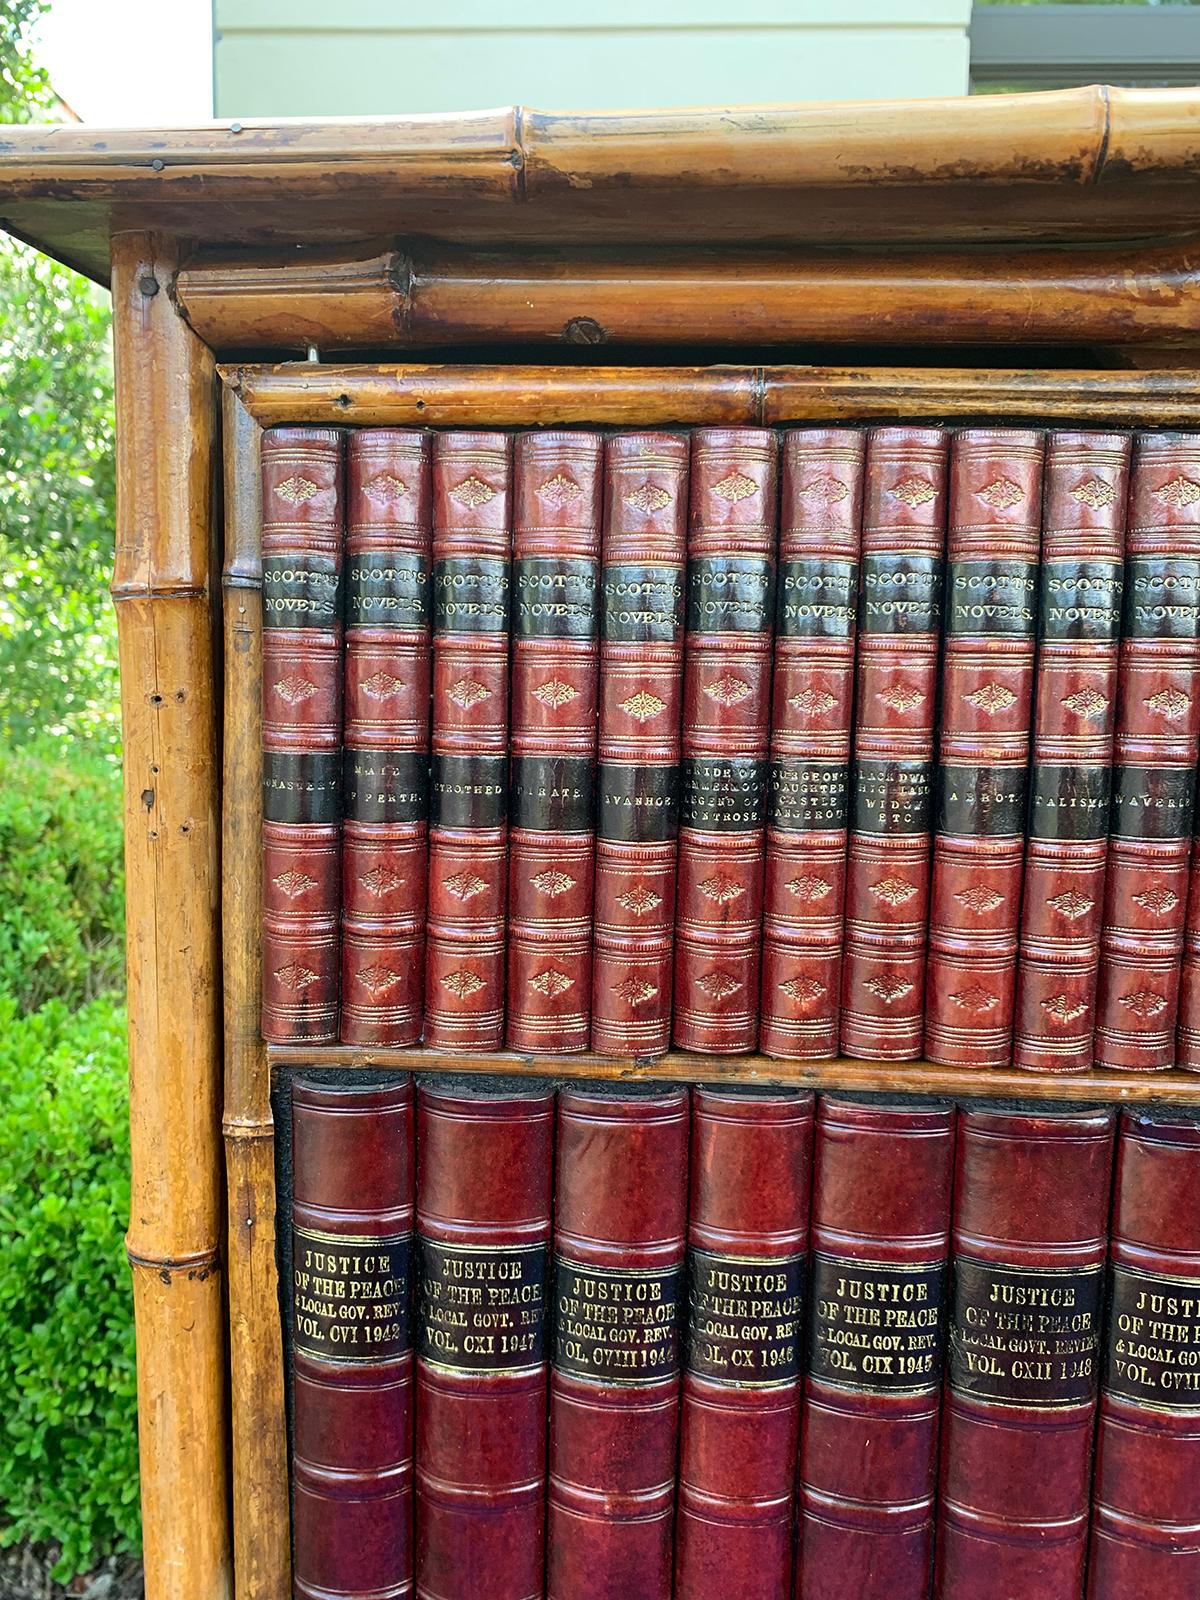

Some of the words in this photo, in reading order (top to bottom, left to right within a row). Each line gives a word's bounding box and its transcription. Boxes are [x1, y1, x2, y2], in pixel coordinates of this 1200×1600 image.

[352, 569, 426, 584] SCOTT'S
[956, 576, 1034, 591] SCOTT'S
[1048, 578, 1123, 593] SCOTT'S
[605, 583, 681, 597] SCOTT'S
[353, 597, 425, 612] NOVELS.
[437, 602, 508, 617] NOVELS.
[956, 606, 1033, 620] NOVELS.
[607, 611, 680, 625] NOVELS.
[779, 795, 837, 806] CASTLE
[879, 812, 915, 823] ETC.
[305, 1251, 390, 1274] JUSTICE
[443, 1259, 522, 1280] JUSTICE
[295, 1270, 310, 1290] OF
[313, 1277, 346, 1299] THE
[349, 1277, 405, 1299] PEACE
[424, 1279, 442, 1299] OF
[447, 1285, 482, 1305] THE
[488, 1284, 542, 1306] PEACE
[573, 1277, 662, 1302] JUSTICE
[708, 1270, 787, 1293] JUSTICE
[837, 1278, 927, 1302] JUSTICE
[990, 1283, 1075, 1307] JUSTICE
[301, 1296, 337, 1318] LOCAL
[339, 1305, 370, 1320] GOV.
[373, 1302, 404, 1320] REV.
[430, 1305, 468, 1327] LOCAL
[473, 1313, 514, 1328] GOVT.
[560, 1296, 579, 1316] OF
[582, 1302, 618, 1324] THE
[622, 1303, 675, 1325] PEACE
[711, 1296, 748, 1318] THE
[751, 1296, 801, 1319] PEACE
[817, 1300, 839, 1320] OF
[843, 1305, 880, 1326] THE
[884, 1308, 938, 1328] PEACE
[966, 1306, 990, 1327] OF
[994, 1311, 1033, 1332] THE
[297, 1314, 325, 1340] VOL.
[329, 1325, 358, 1343] CVI
[426, 1326, 459, 1352] VOL.
[463, 1335, 495, 1354] CXI
[501, 1332, 537, 1354] 1947
[567, 1320, 607, 1342] LOCAL
[609, 1328, 641, 1344] GOV.
[643, 1325, 673, 1344] REV.
[741, 1326, 773, 1341] GOV.
[827, 1328, 870, 1349] LOCAL
[872, 1335, 905, 1351] GOV.
[907, 1334, 936, 1351] REV.
[1118, 1314, 1144, 1335] OF
[1148, 1320, 1189, 1343] THE
[961, 1327, 1006, 1351] LOCAL
[1008, 1338, 1051, 1355] GOVT.
[1115, 1338, 1125, 1353] &
[1127, 1341, 1175, 1364] LOCAL
[593, 1347, 637, 1368] CVIII
[731, 1349, 754, 1367] CX
[761, 1346, 794, 1367] 1946
[862, 1355, 894, 1375] CIX
[898, 1354, 932, 1375] 1945
[965, 1351, 1005, 1377] VOL.
[1011, 1361, 1053, 1380] CXII
[1060, 1358, 1092, 1380] 1948
[1115, 1359, 1156, 1386] VOL.
